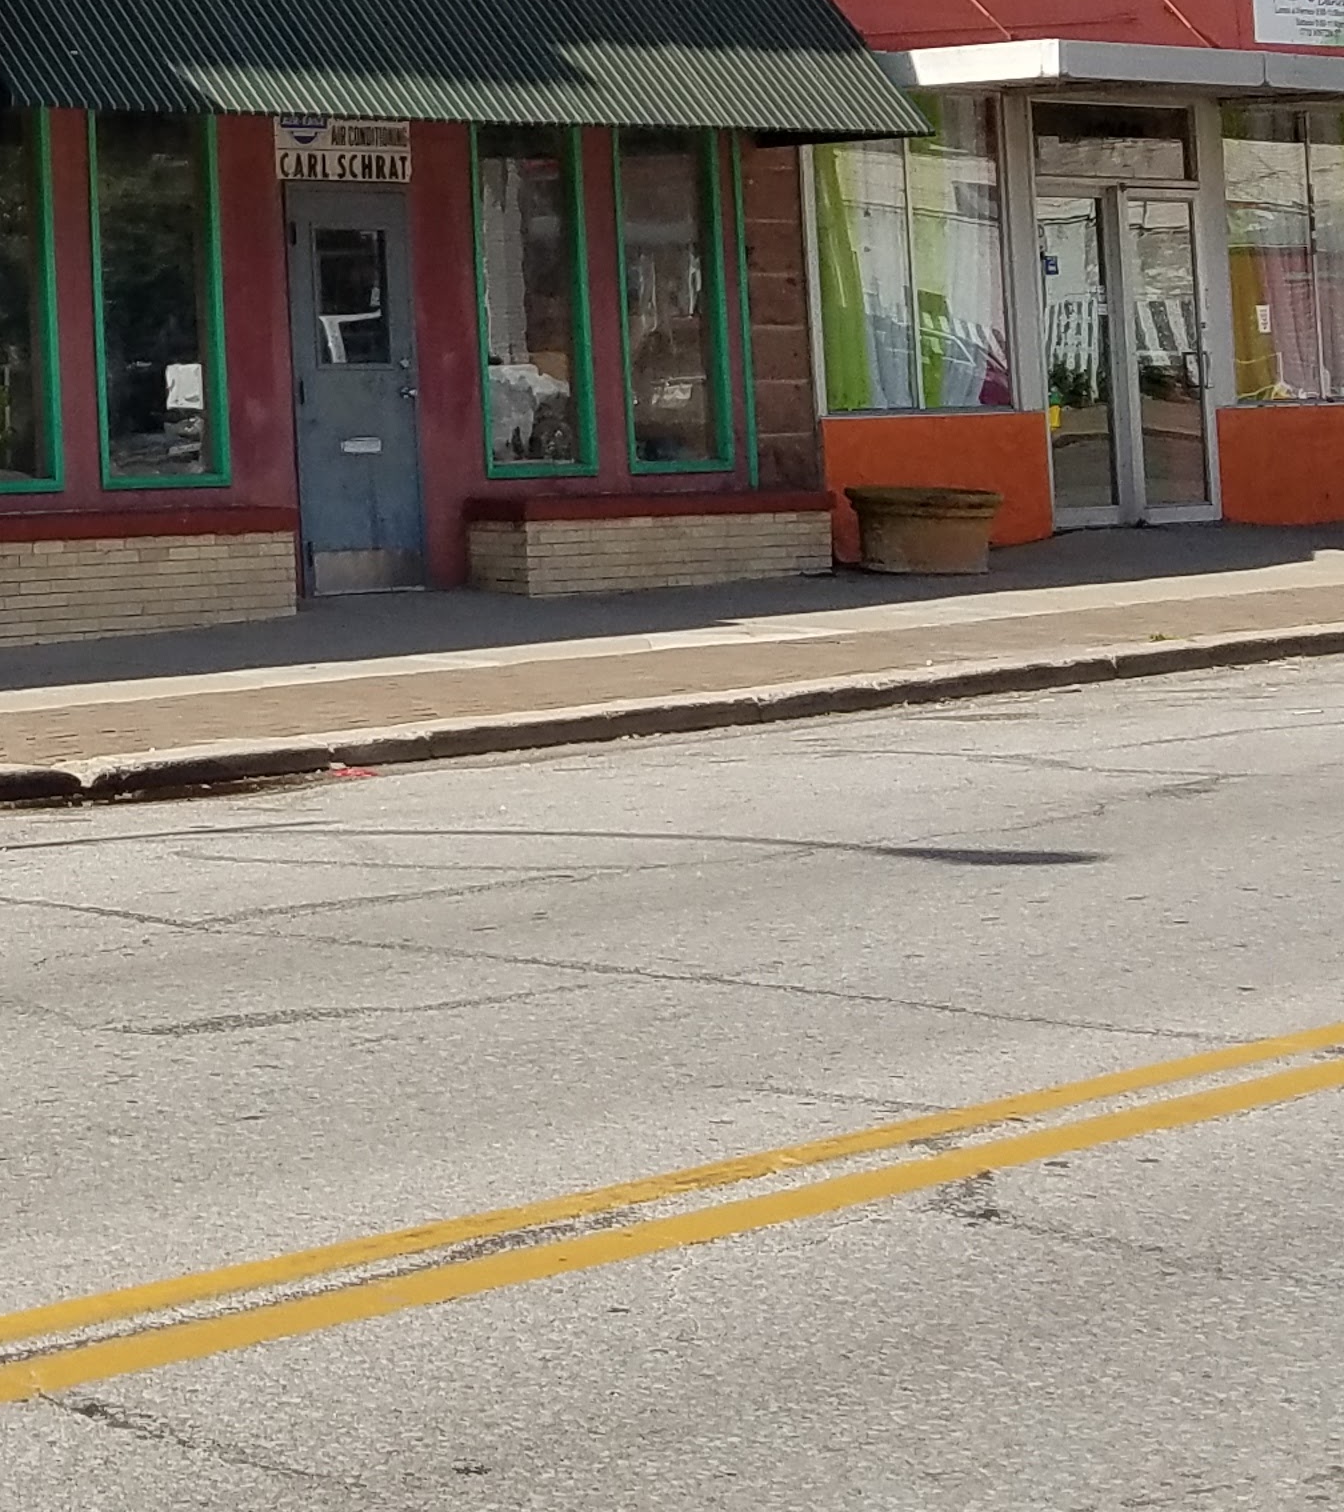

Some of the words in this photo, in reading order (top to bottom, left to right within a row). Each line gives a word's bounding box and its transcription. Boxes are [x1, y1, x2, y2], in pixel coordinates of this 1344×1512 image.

[331, 125, 346, 146] AIR
[347, 126, 408, 147] CONDITIONING
[280, 152, 330, 178] CARL
[337, 154, 408, 180] SCHRAT
